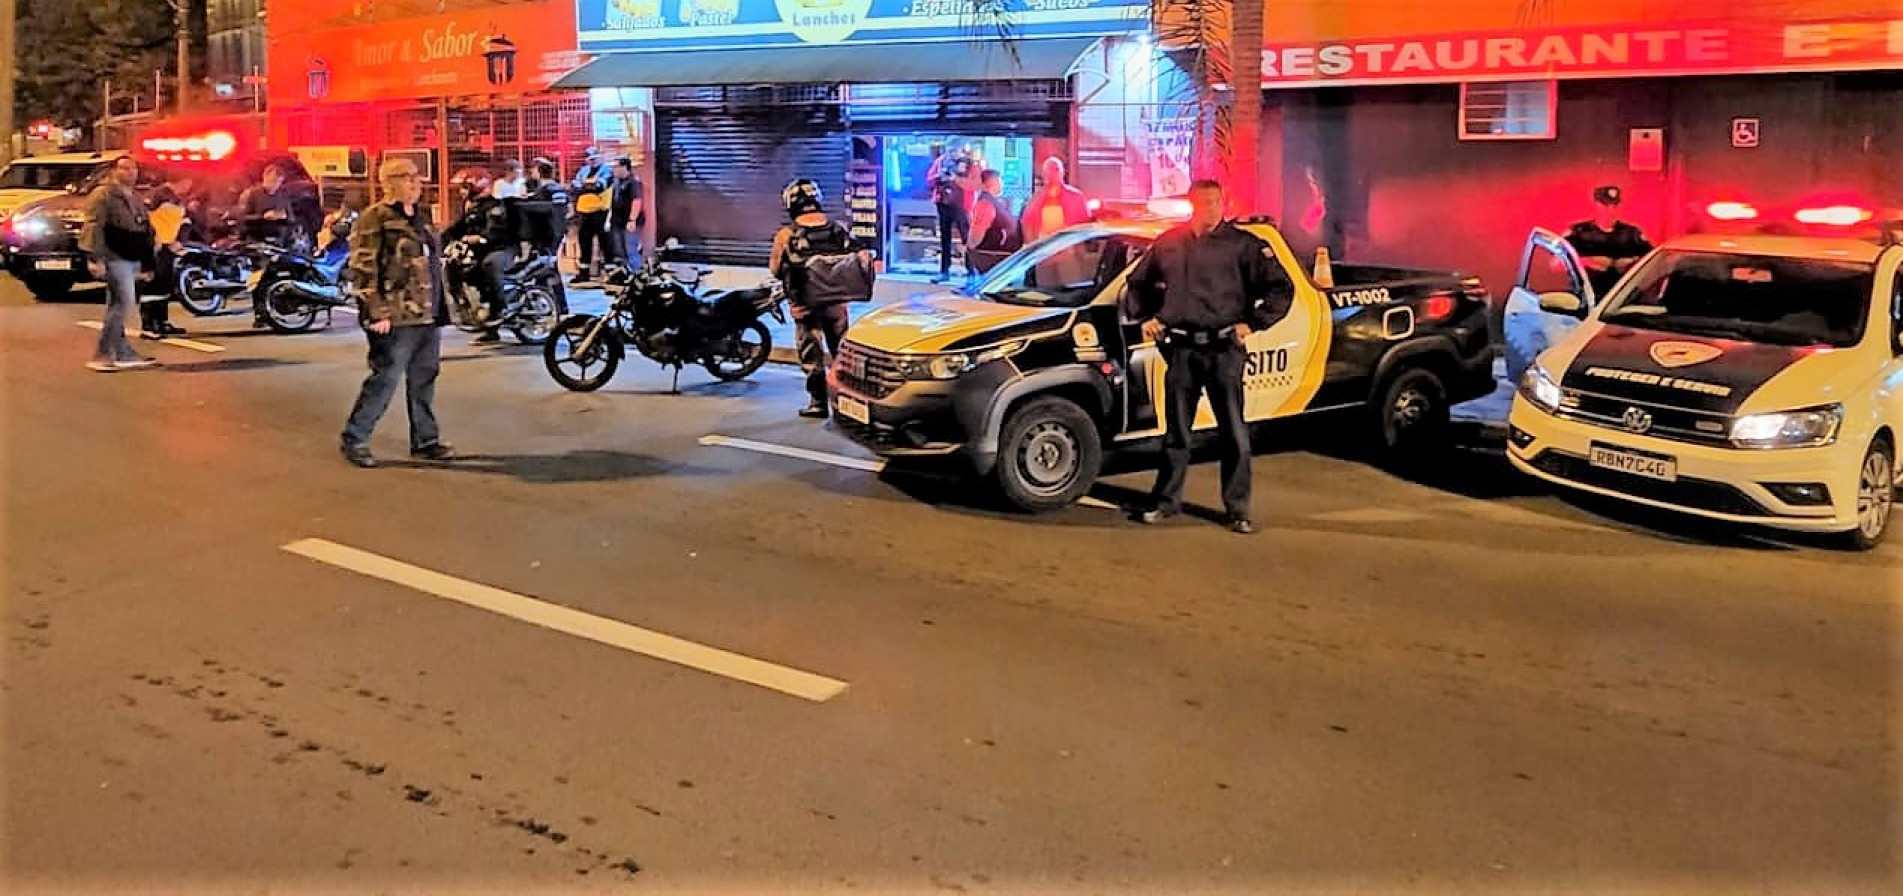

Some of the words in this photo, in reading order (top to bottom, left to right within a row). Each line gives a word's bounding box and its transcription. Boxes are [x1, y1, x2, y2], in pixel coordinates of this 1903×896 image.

[419, 20, 478, 64] Sabor
[1261, 28, 1729, 77] RESTAURANTE
[1331, 287, 1393, 308] VT-1002
